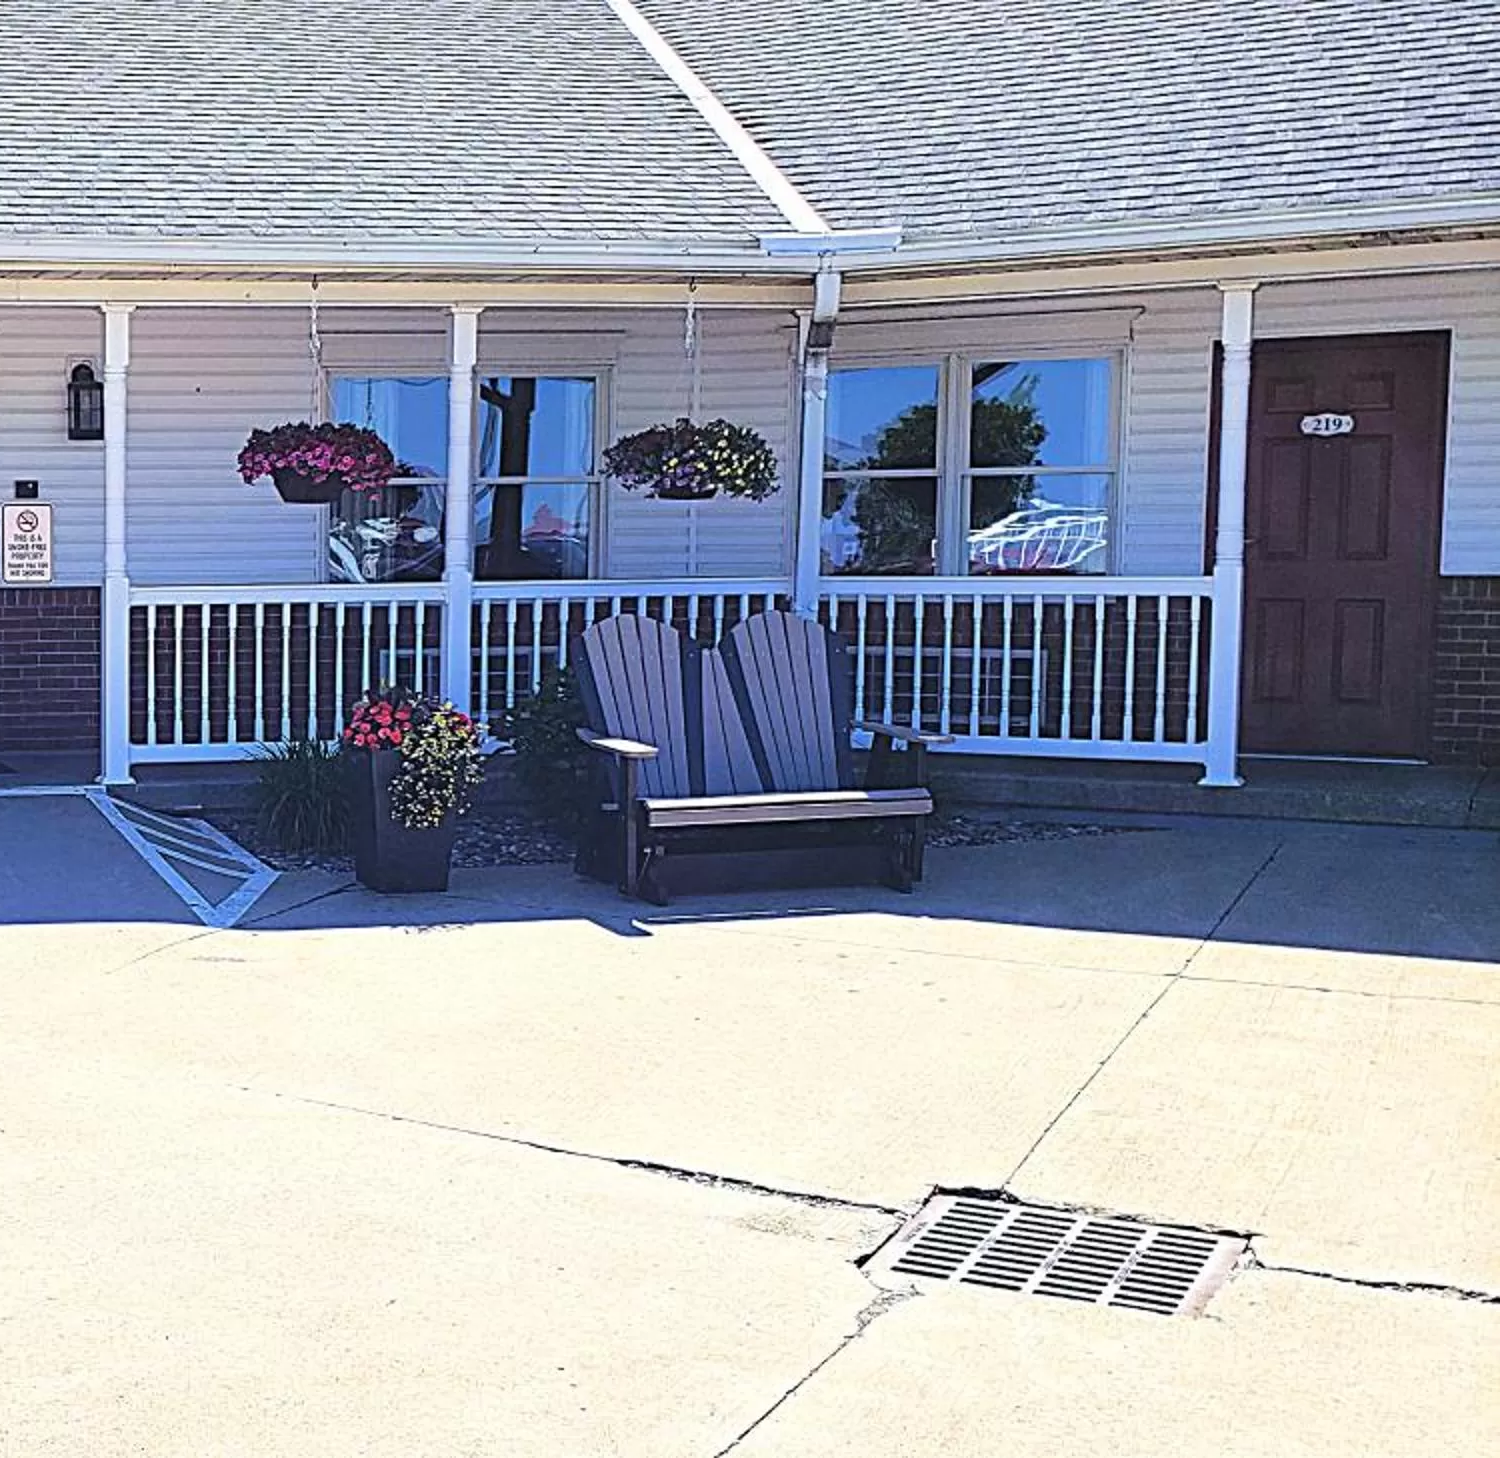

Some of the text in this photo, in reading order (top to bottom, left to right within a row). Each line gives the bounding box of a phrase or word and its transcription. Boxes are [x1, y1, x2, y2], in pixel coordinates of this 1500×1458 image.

[1311, 417, 1343, 431] 219
[13, 533, 43, 542] THIS IS A
